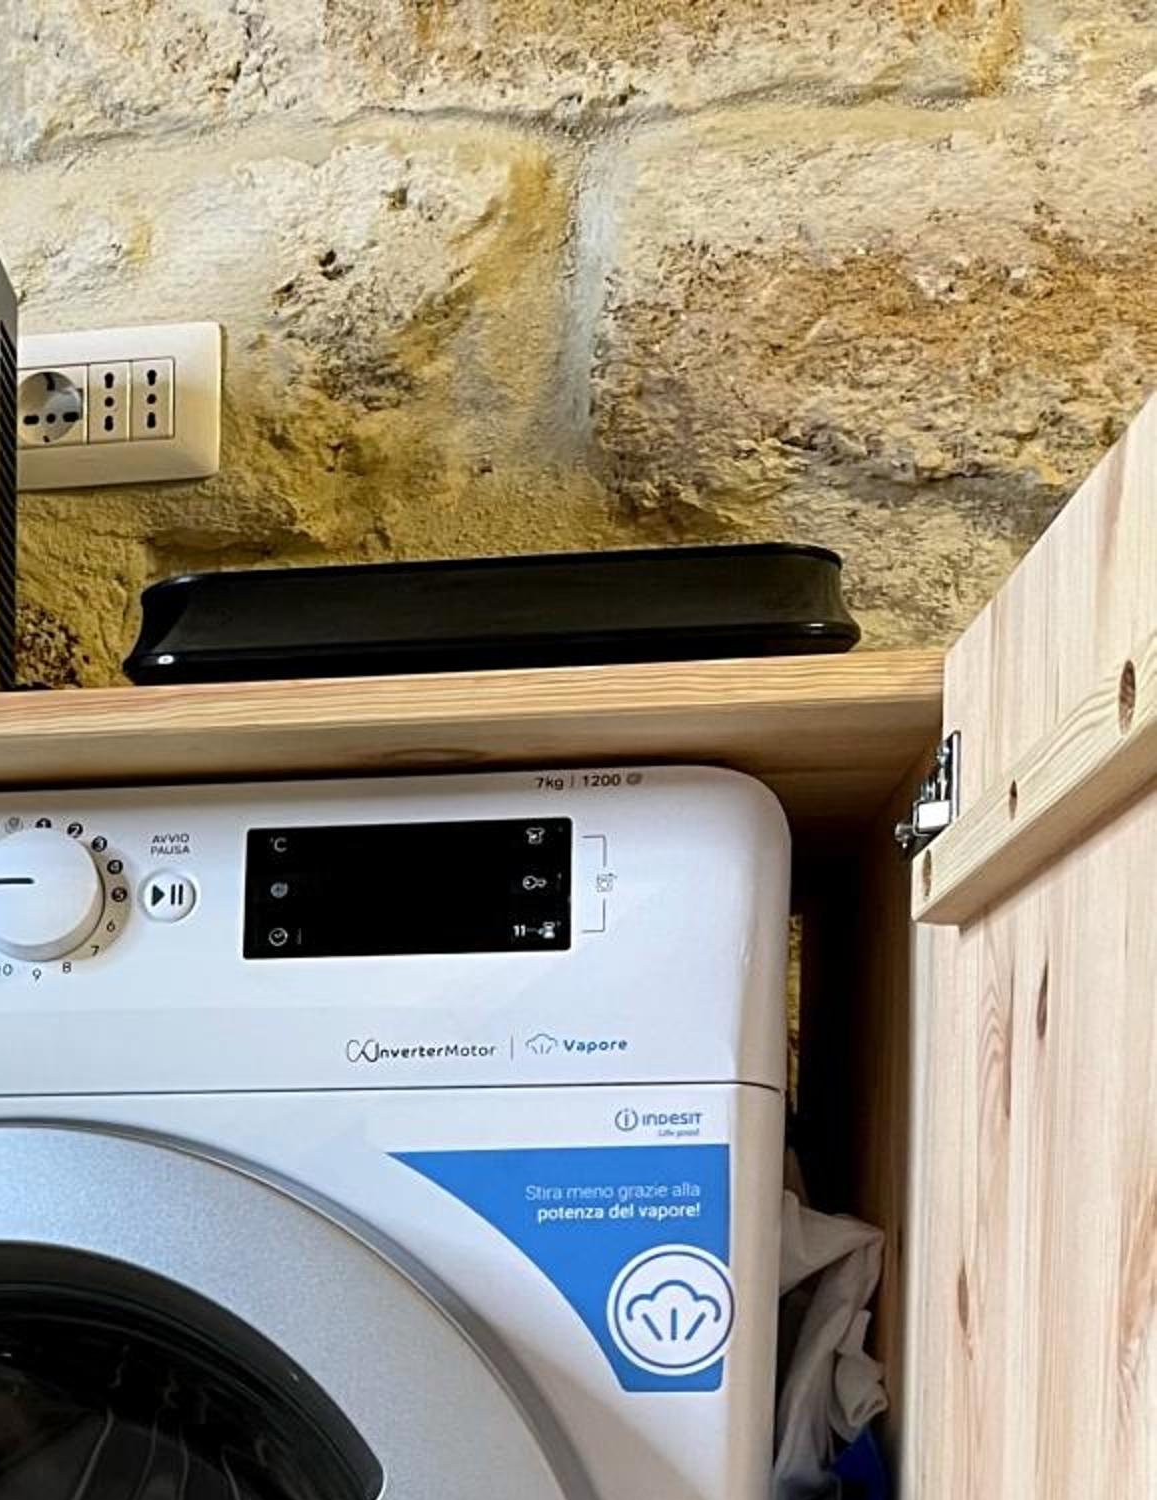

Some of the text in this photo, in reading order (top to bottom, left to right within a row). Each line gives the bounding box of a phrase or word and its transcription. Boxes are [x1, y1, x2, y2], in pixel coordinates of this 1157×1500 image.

[583, 774, 621, 787] 1200
[152, 834, 189, 844] AVVIO
[151, 845, 190, 855] PAUSA
[107, 920, 115, 932] 6
[91, 946, 100, 957] 7
[62, 962, 72, 973] 8
[32, 969, 41, 981] 9
[563, 1039, 628, 1054] Vapore
[525, 1181, 700, 1201] Stira meno grazie alla
[538, 1203, 700, 1222] potenza del vapore!
